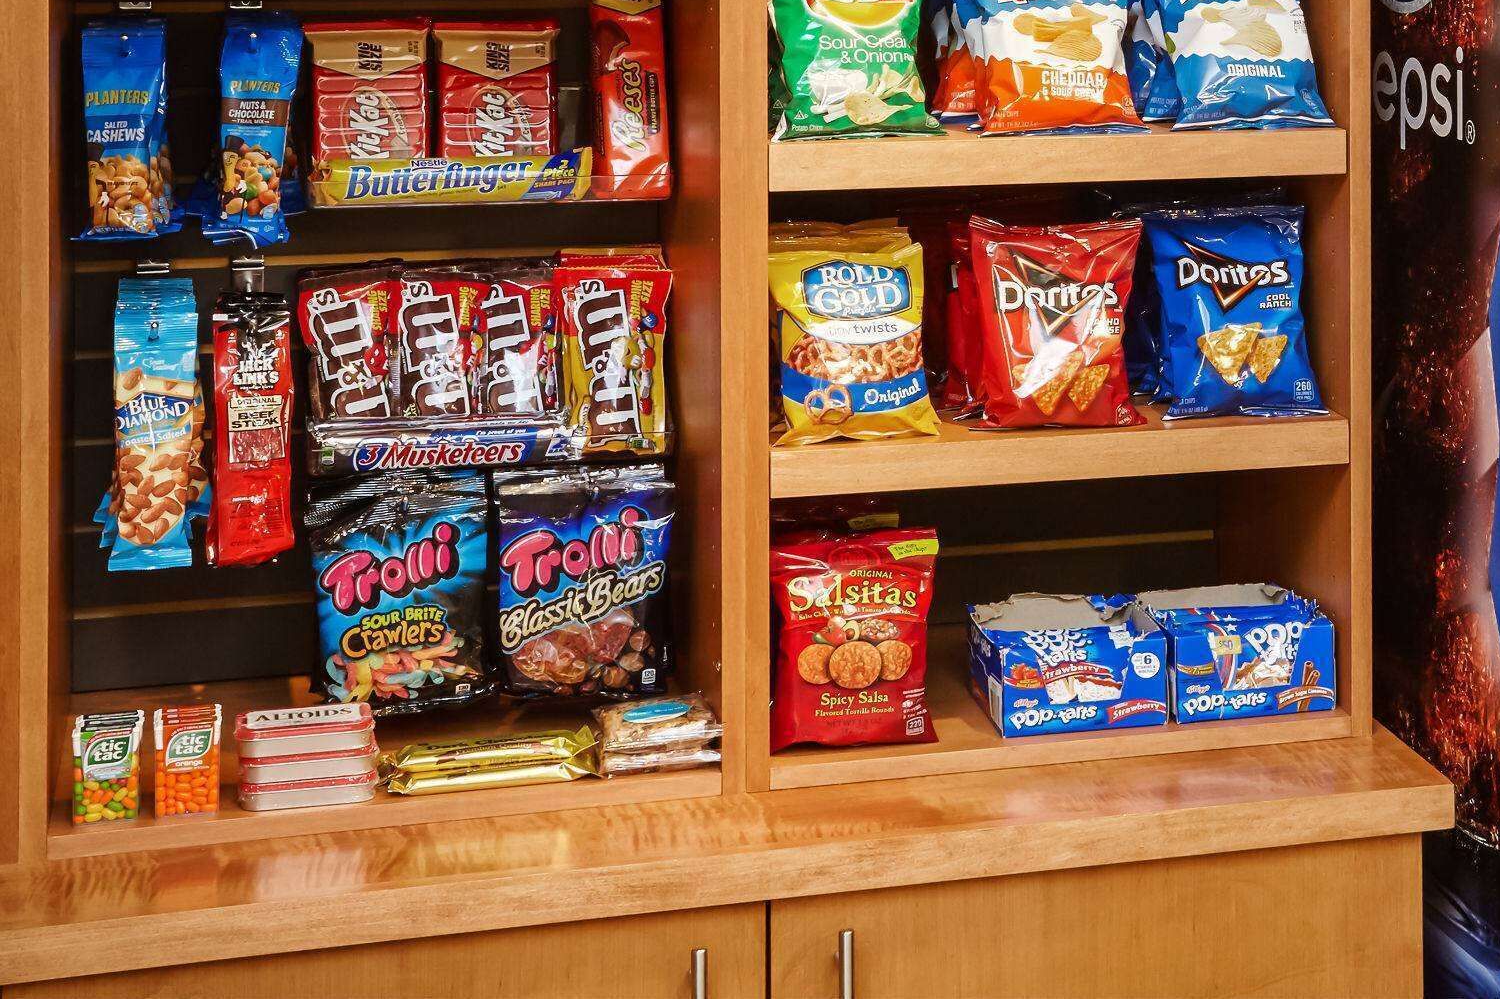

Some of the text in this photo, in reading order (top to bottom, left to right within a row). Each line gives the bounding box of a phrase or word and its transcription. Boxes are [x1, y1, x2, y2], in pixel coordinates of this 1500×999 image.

[819, 35, 859, 50] Sour
[370, 41, 383, 72] SIZE
[497, 42, 510, 72] SIZE
[840, 49, 904, 64] & Onion
[1041, 70, 1106, 87] CHEDDAR
[1227, 64, 1286, 78] ORIGINAL
[230, 80, 282, 94] PLANTERS
[85, 89, 150, 106] PLANTERS
[240, 101, 260, 110] NUTS
[611, 58, 647, 151] Reese's
[1374, 46, 1463, 150] epsi
[228, 109, 275, 119] CHOCOLATE
[104, 120, 128, 129] SALTED
[87, 127, 146, 143] CASHEWS
[346, 161, 532, 199] Butterfinger
[817, 264, 894, 286] ROLD
[1177, 257, 1289, 288] Doritos
[813, 282, 903, 313] GOLD
[998, 281, 1118, 312] Doritos
[1266, 294, 1291, 302] COOL
[1259, 301, 1293, 309] RANCH
[854, 320, 898, 335] twists
[239, 358, 274, 372] JACK
[864, 378, 922, 406] Original
[130, 396, 168, 416] BLUE
[237, 410, 274, 420] BEEF
[157, 428, 187, 443] Salted
[359, 441, 523, 468] 3 Musketeers
[501, 507, 642, 593] Trolli
[322, 521, 456, 612] Trolli
[849, 569, 893, 579] ORIGINAL
[786, 573, 917, 612] Salsitas
[501, 564, 663, 647] Classic Bears
[361, 610, 400, 630] SOUR
[340, 620, 445, 657] Crawlers
[820, 691, 855, 707] Spicy
[858, 691, 889, 703] Salsa
[255, 706, 353, 722] ALTOIDS
[815, 708, 845, 717] Flavored
[1112, 702, 1160, 719] Strawberry
[100, 737, 126, 752] tic
[182, 732, 207, 747] tic
[94, 749, 123, 762] tac
[174, 743, 204, 756] tac
[174, 758, 203, 767] orange
